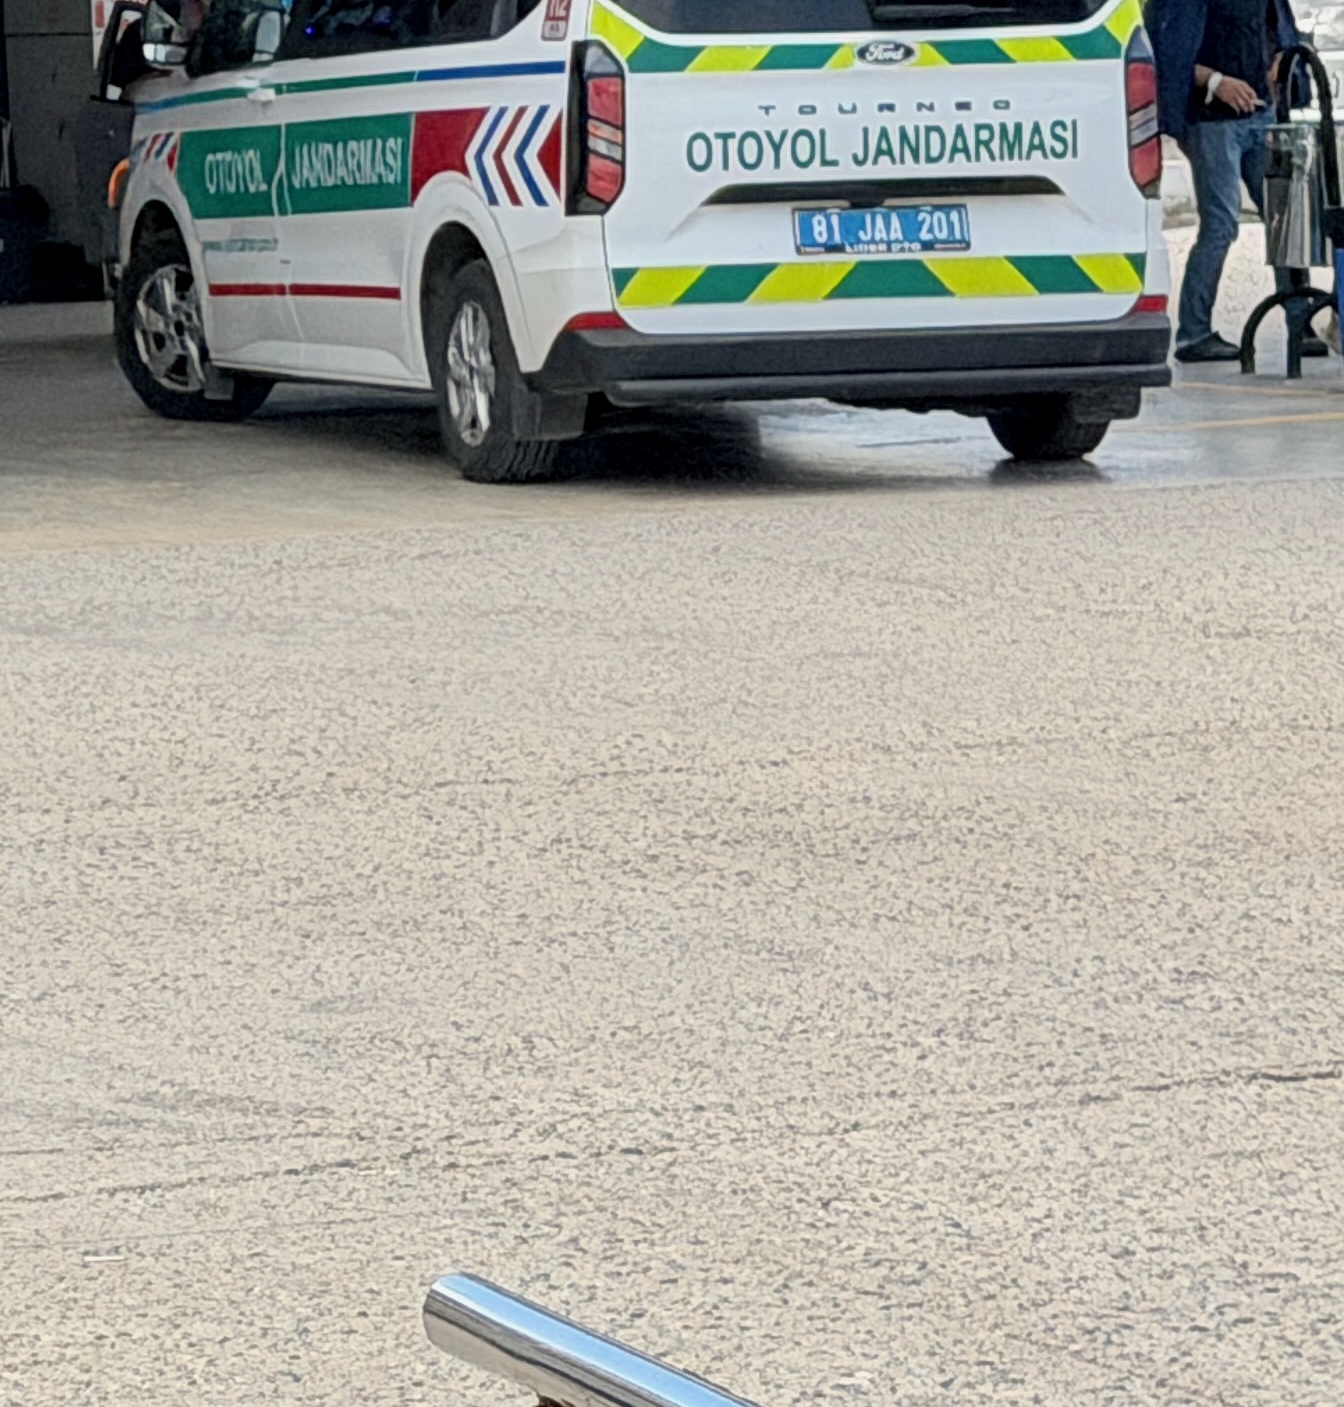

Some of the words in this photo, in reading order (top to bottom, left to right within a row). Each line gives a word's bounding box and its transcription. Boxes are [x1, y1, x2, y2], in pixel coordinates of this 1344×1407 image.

[862, 43, 907, 62] Ford
[757, 99, 1011, 116] TOURNEO
[686, 128, 839, 172] OTOYOL
[852, 119, 1079, 167] JANDARMASI
[204, 149, 268, 194] OTOYOL
[291, 137, 403, 189] JANDARMASI
[812, 213, 841, 243] 81
[858, 212, 903, 241] JAA
[917, 210, 961, 241] 201
